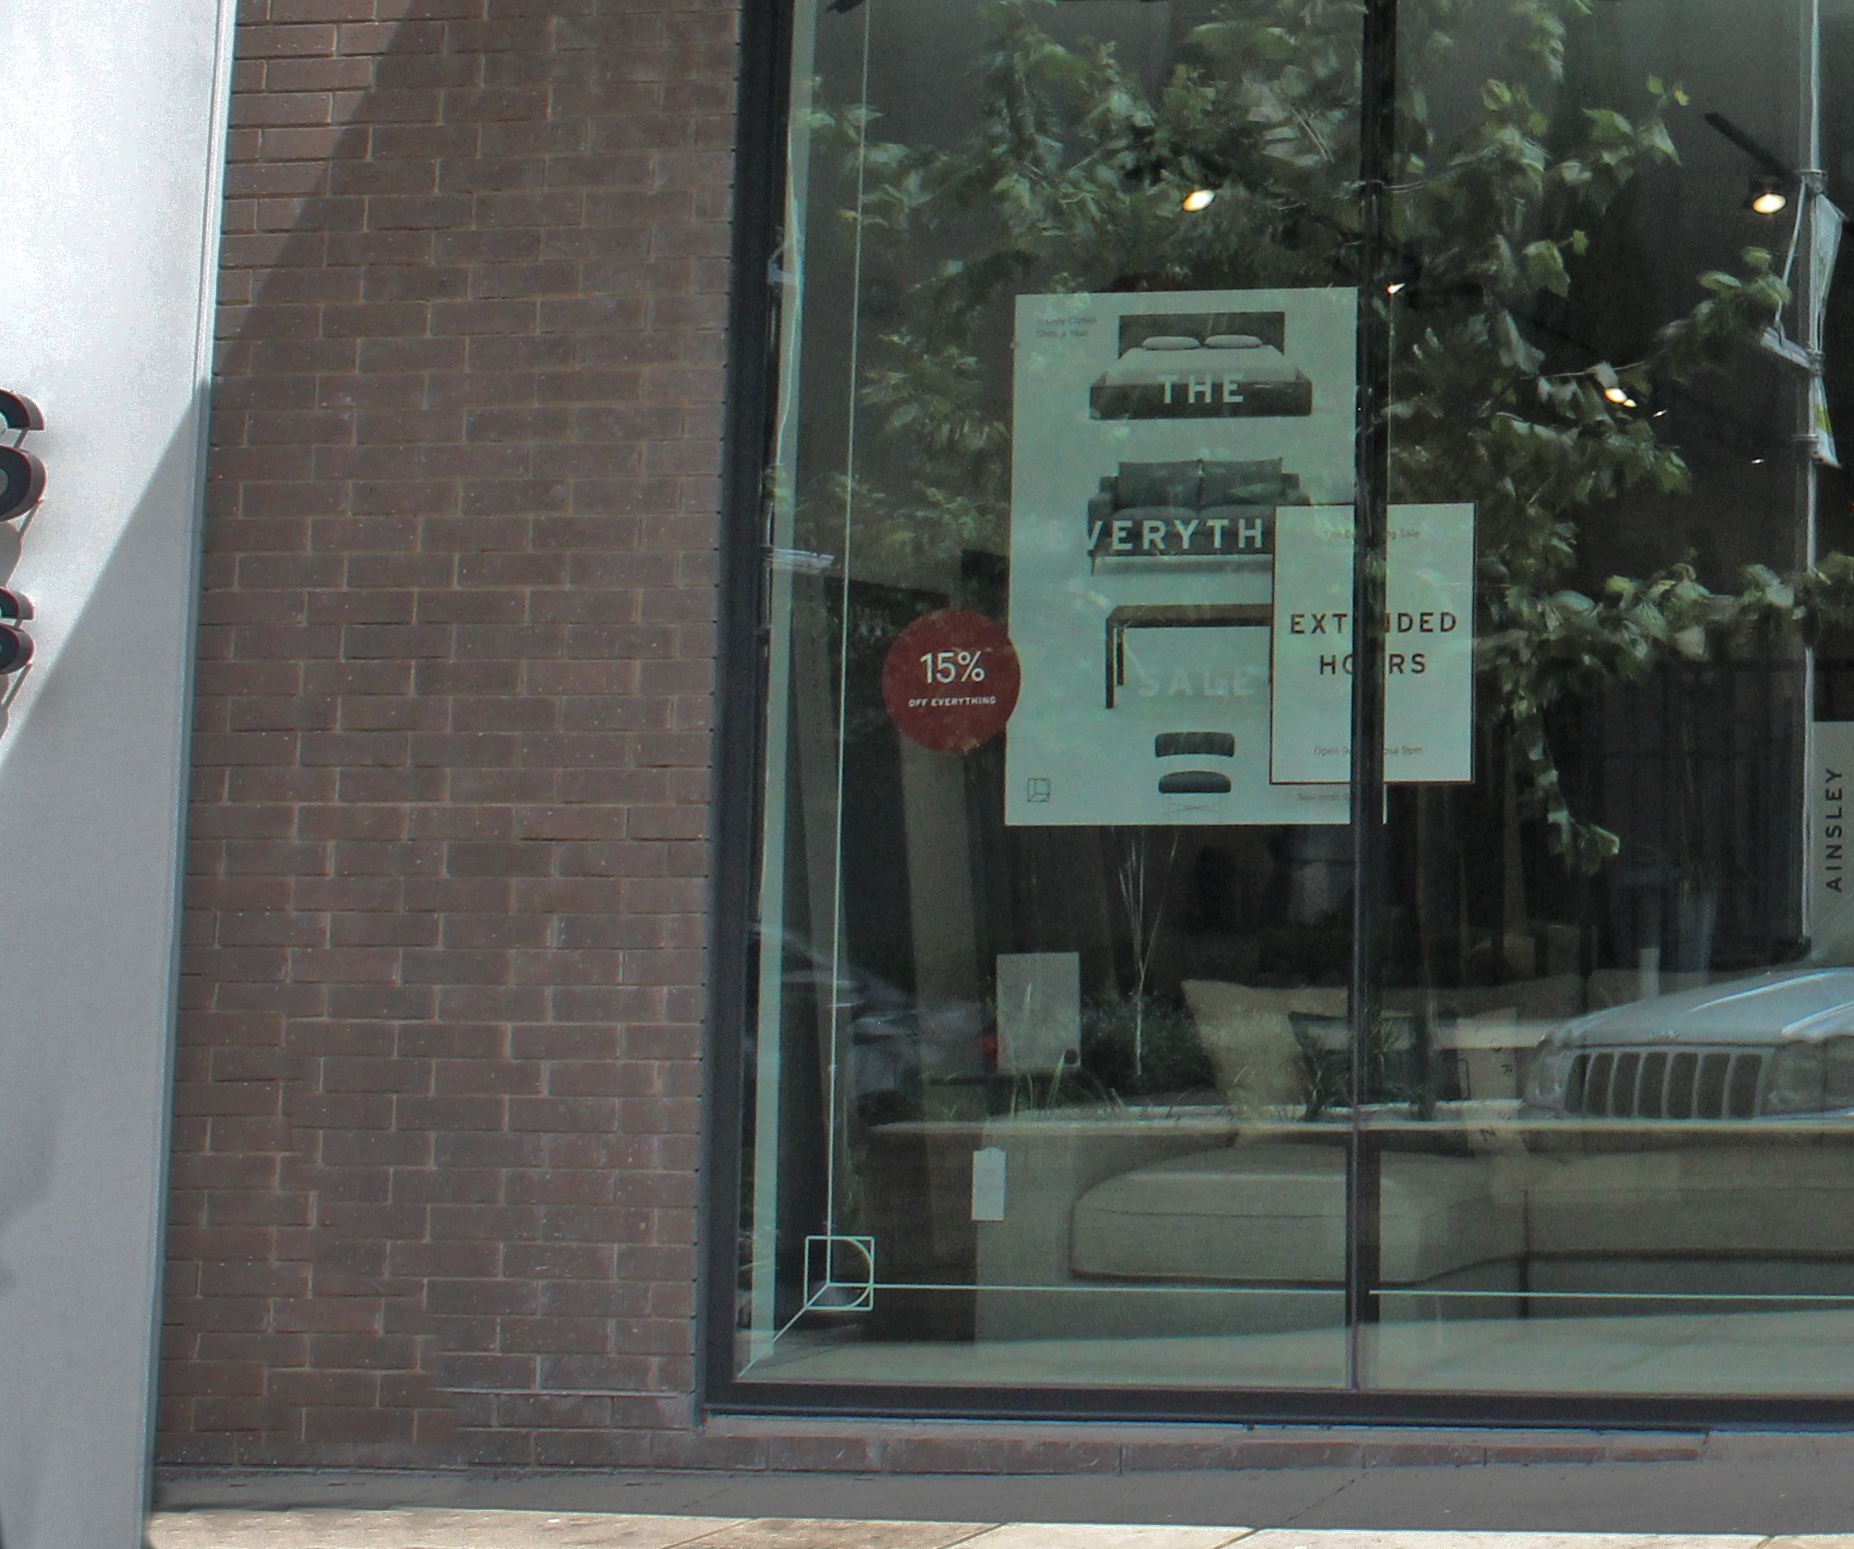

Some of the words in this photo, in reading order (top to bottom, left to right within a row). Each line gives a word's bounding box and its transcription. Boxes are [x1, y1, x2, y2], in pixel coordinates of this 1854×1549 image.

[1157, 371, 1244, 404] THE
[1290, 612, 1457, 634] EXTDED
[920, 651, 985, 684] 15%
[908, 698, 928, 707] OFF
[931, 696, 996, 707] EVERYTHING
[1825, 767, 1843, 893] AINSLEY
